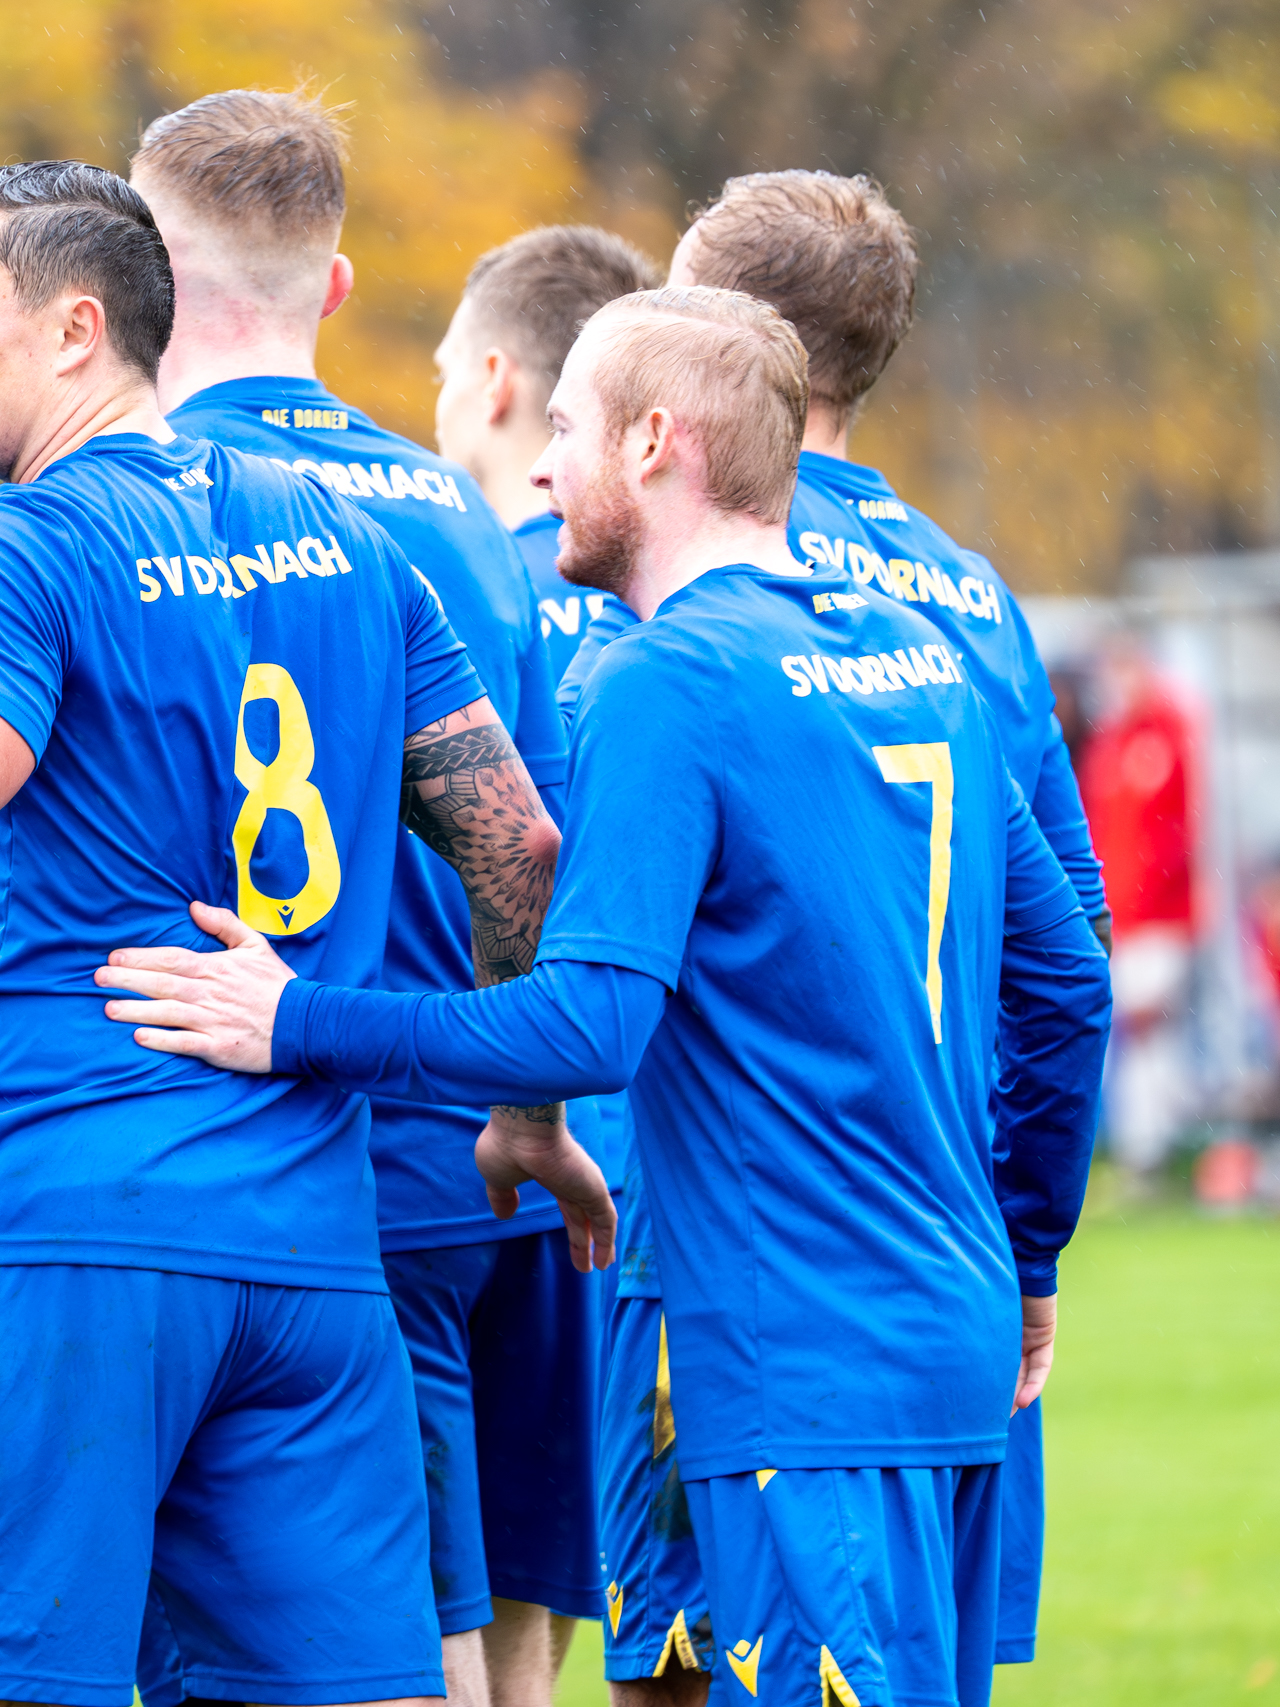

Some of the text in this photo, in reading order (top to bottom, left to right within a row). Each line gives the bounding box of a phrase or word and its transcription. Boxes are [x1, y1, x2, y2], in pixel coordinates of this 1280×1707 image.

[269, 458, 467, 512] ORNACH
[136, 556, 184, 602] SV
[185, 535, 353, 599] DONACH
[799, 531, 1002, 624] SV DORNACH
[781, 644, 963, 697] SV DORNACH
[232, 663, 341, 936] 8
[872, 742, 954, 1044] 7
